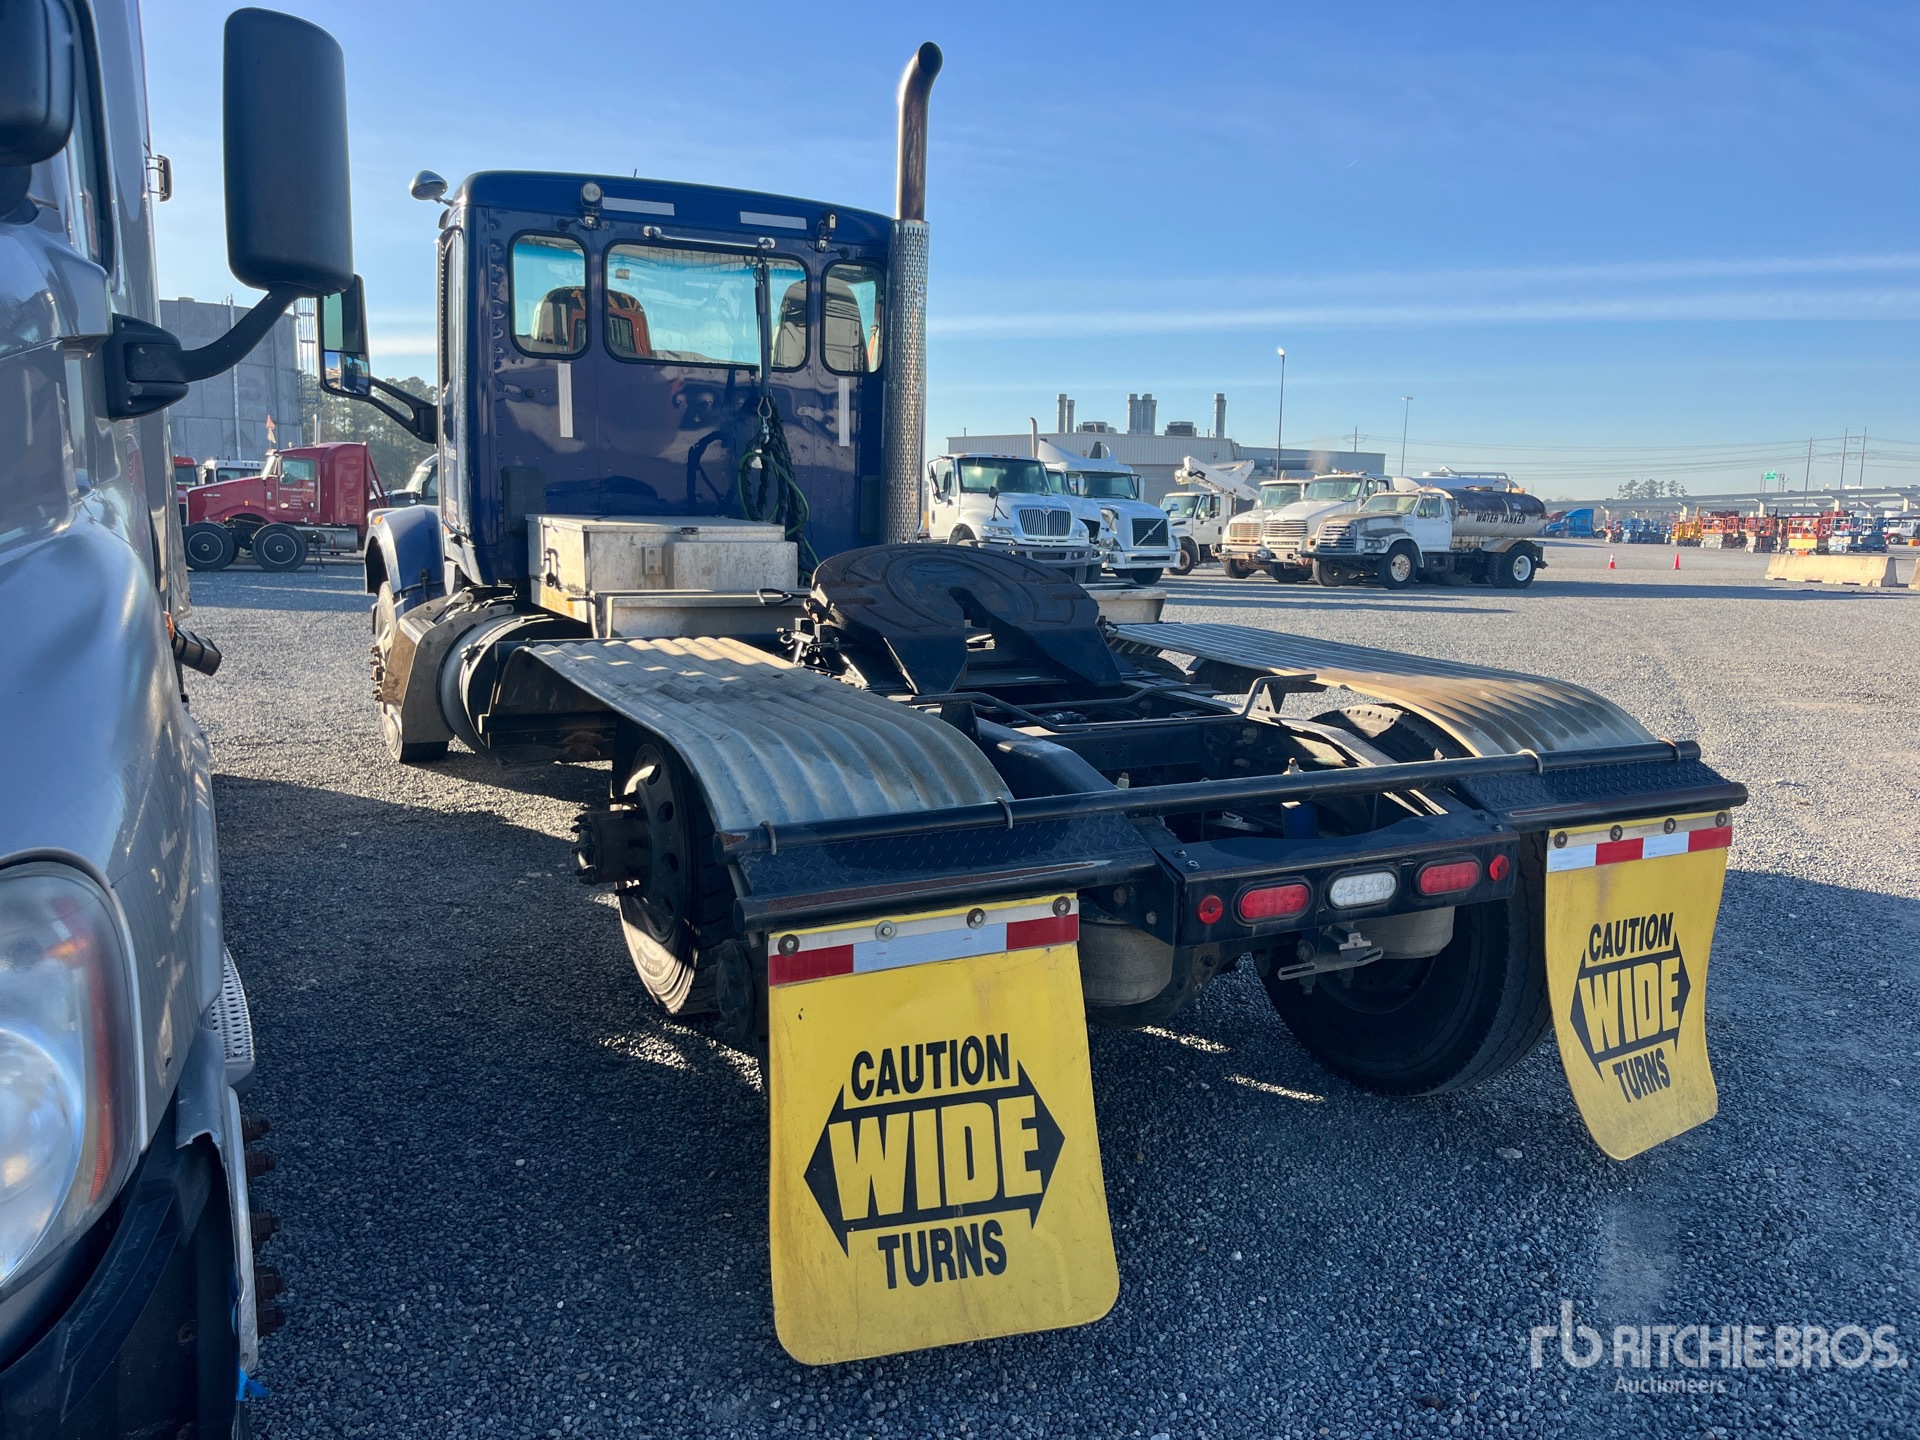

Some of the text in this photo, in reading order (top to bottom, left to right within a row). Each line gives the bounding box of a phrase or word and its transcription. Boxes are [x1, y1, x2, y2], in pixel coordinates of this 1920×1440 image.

[1476, 513, 1527, 525] WATER TANKER
[1589, 912, 1674, 962] CAUTION
[1578, 957, 1680, 1054] WIDE
[851, 1033, 1010, 1101] CAUTION
[1612, 1048, 1670, 1103] TURNS
[828, 1095, 1043, 1221] WIDE
[877, 1219, 1007, 1289] TURNS
